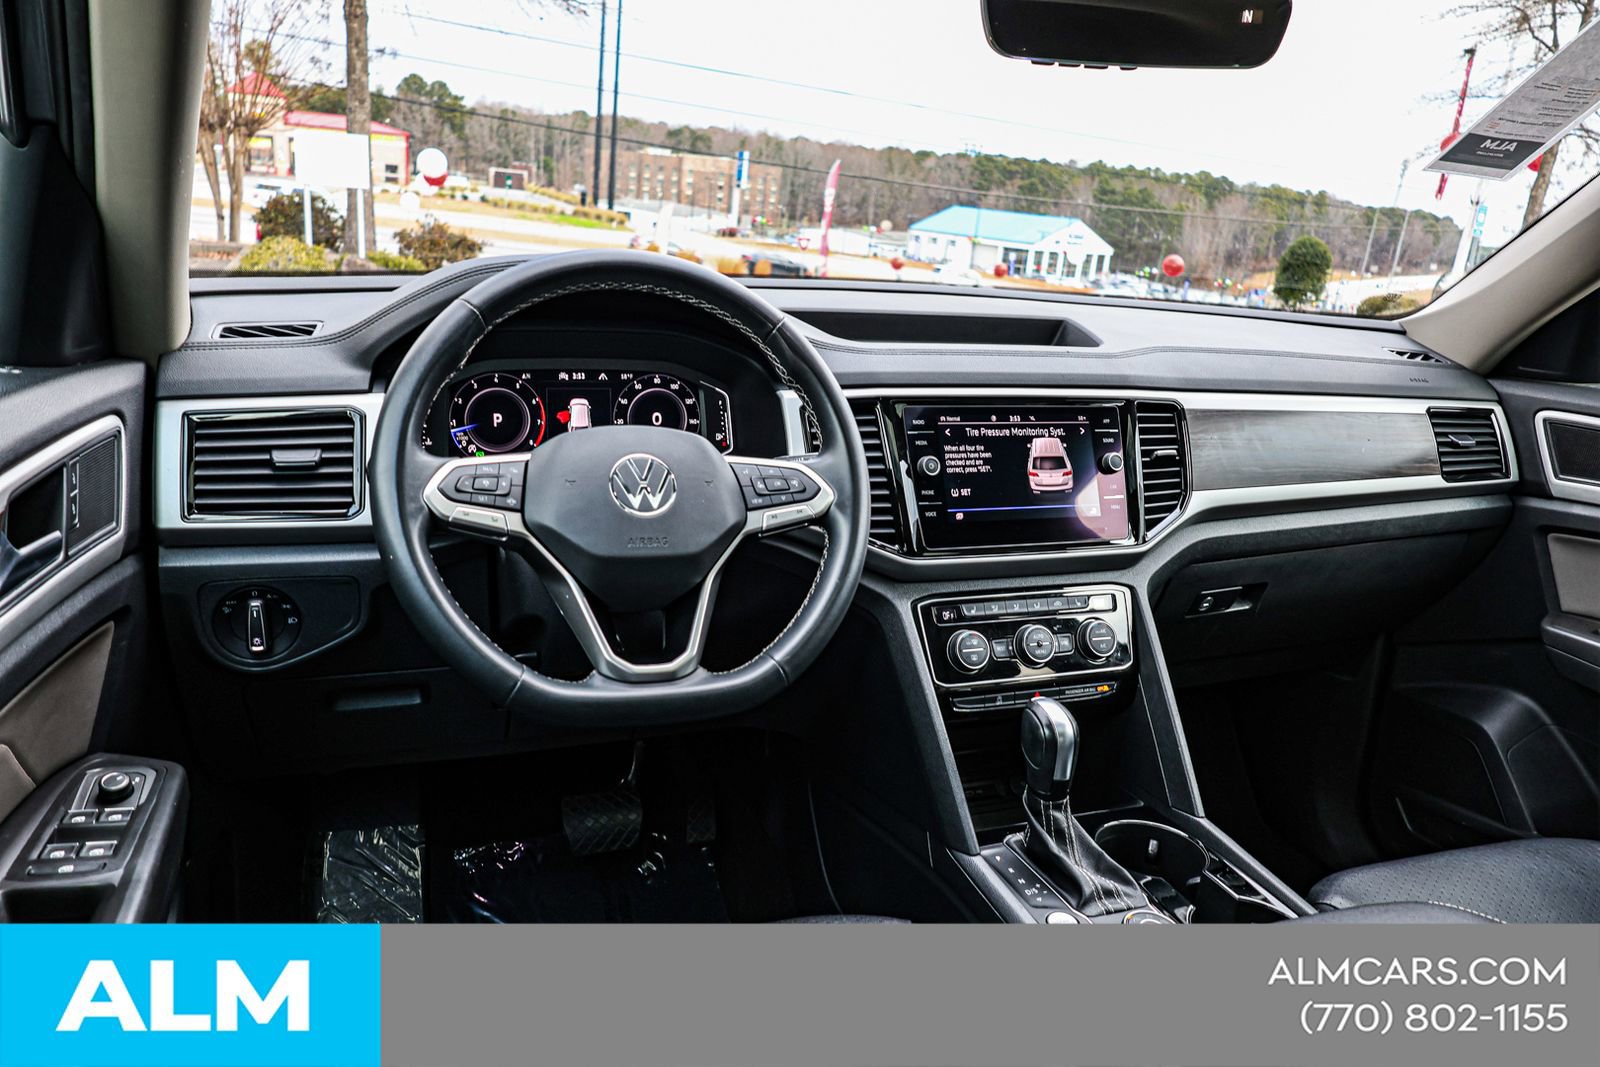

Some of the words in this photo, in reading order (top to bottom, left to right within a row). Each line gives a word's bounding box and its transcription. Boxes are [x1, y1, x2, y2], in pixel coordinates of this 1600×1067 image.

[1241, 9, 1254, 24] N
[493, 412, 503, 428] P
[651, 411, 663, 426] 0
[965, 427, 979, 437] Tire
[980, 427, 1010, 437] Pressure
[1011, 427, 1049, 438] Monitoring
[1050, 427, 1066, 437] Syst.
[944, 452, 967, 460] pressures
[946, 466, 965, 474] correct,
[965, 466, 978, 474] press
[960, 487, 971, 496] SET
[627, 536, 669, 548] AIRBAG
